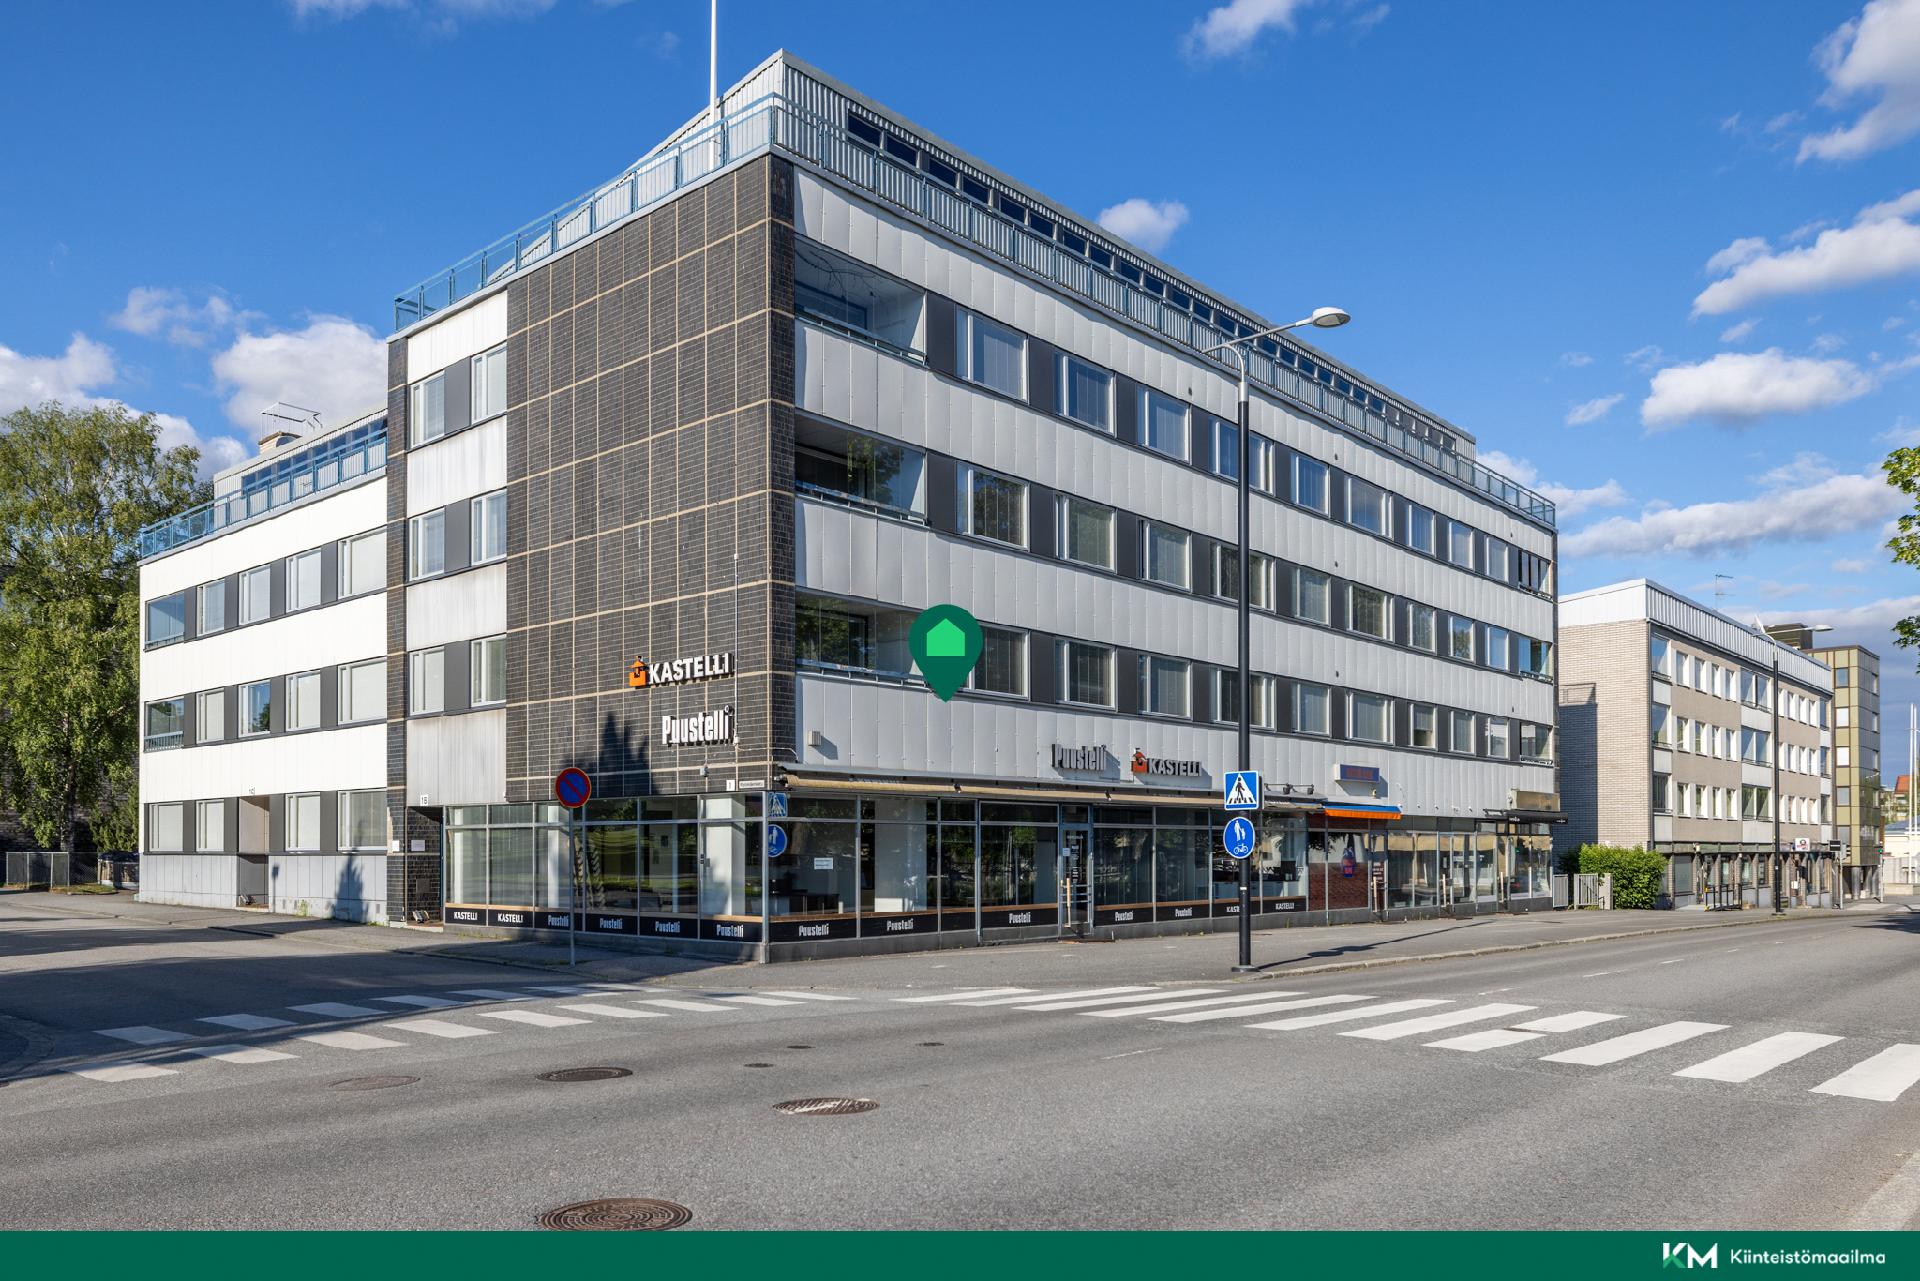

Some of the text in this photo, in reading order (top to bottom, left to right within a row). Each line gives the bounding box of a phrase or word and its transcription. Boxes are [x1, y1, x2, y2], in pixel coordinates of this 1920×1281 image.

[649, 653, 730, 684] KASTELLI
[662, 705, 730, 744] Puustelli
[1052, 744, 1107, 771] Puustelli
[1149, 758, 1201, 776] KASTELLI
[454, 911, 477, 921] KASTELLI
[498, 913, 523, 923] KASTELLI
[717, 924, 744, 938] Puustelli
[799, 923, 829, 936] Puustelli
[887, 918, 914, 931] Puustelli
